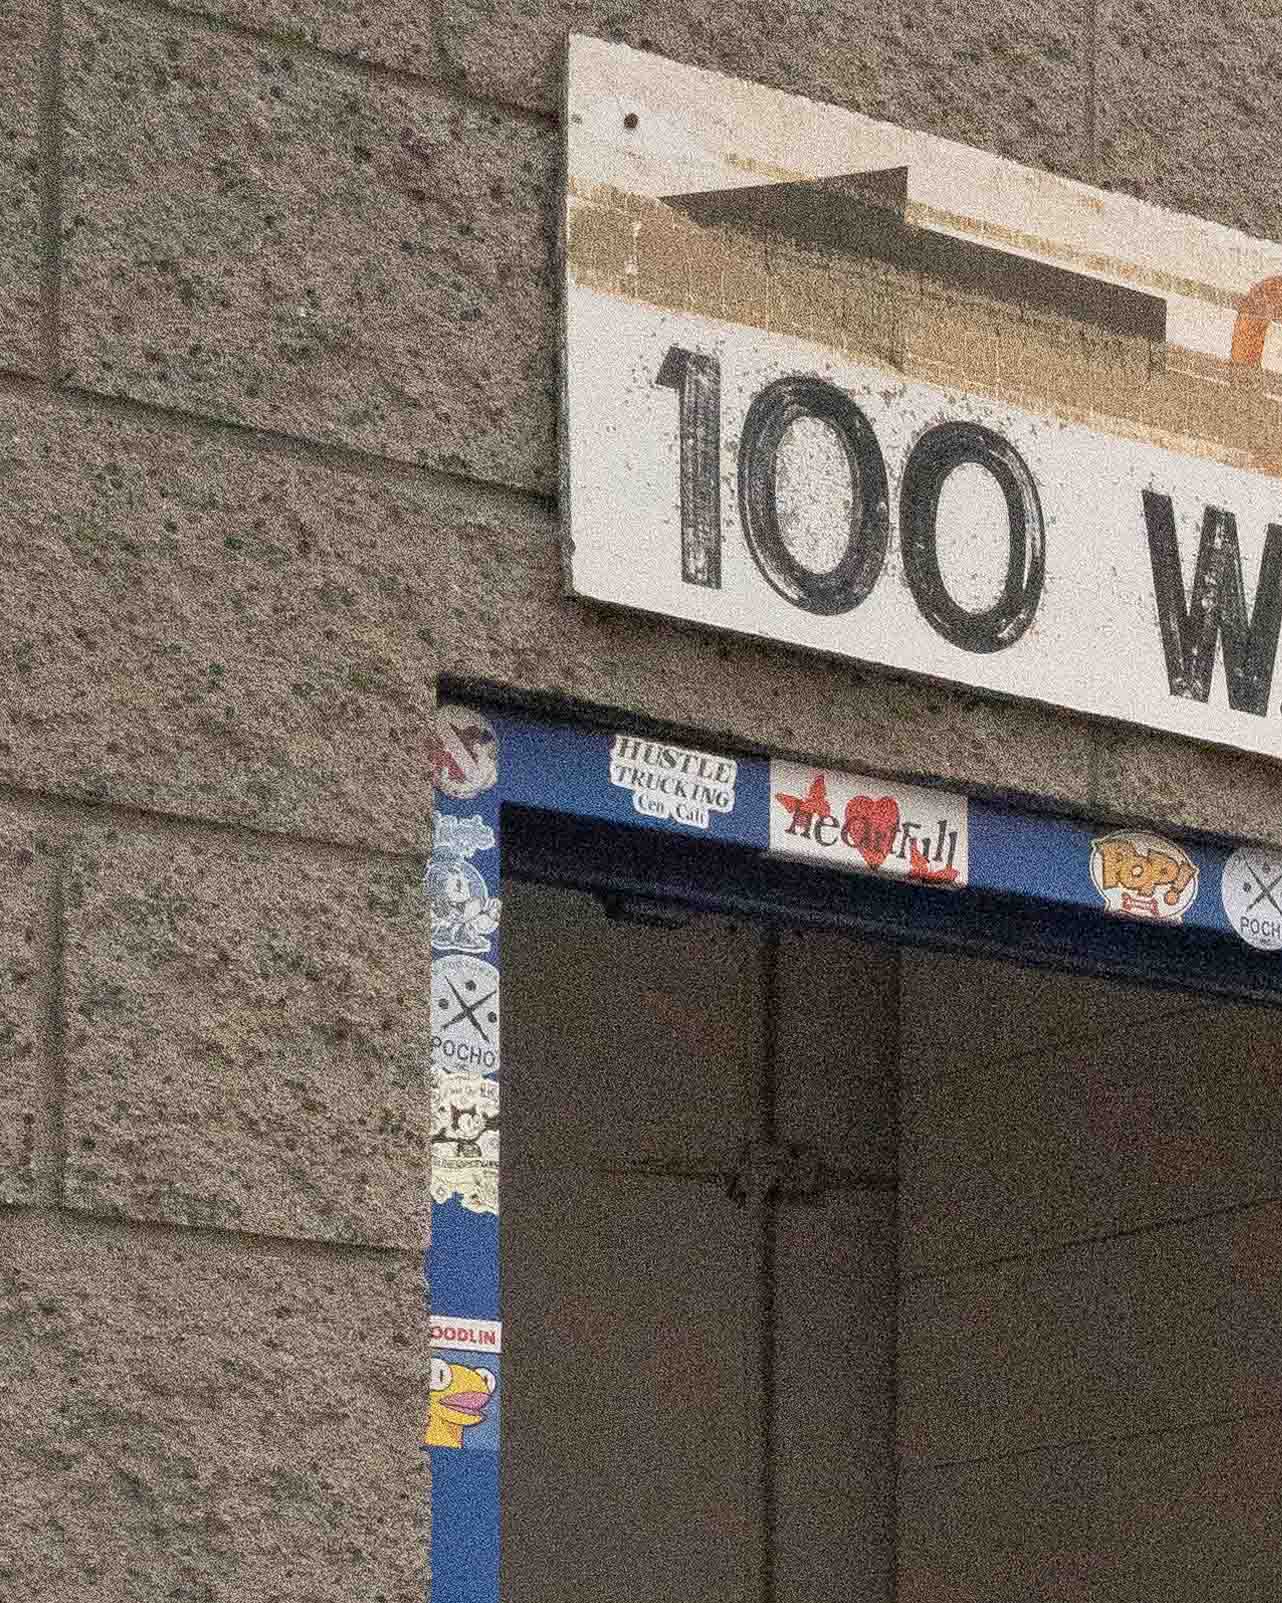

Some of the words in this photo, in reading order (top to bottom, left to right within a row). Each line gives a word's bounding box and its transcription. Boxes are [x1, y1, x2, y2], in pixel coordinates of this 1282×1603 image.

[655, 345, 1046, 654] 100
[617, 738, 734, 783] HUSTLE
[615, 764, 731, 808] TRUCKING
[431, 1035, 496, 1068] POCHO
